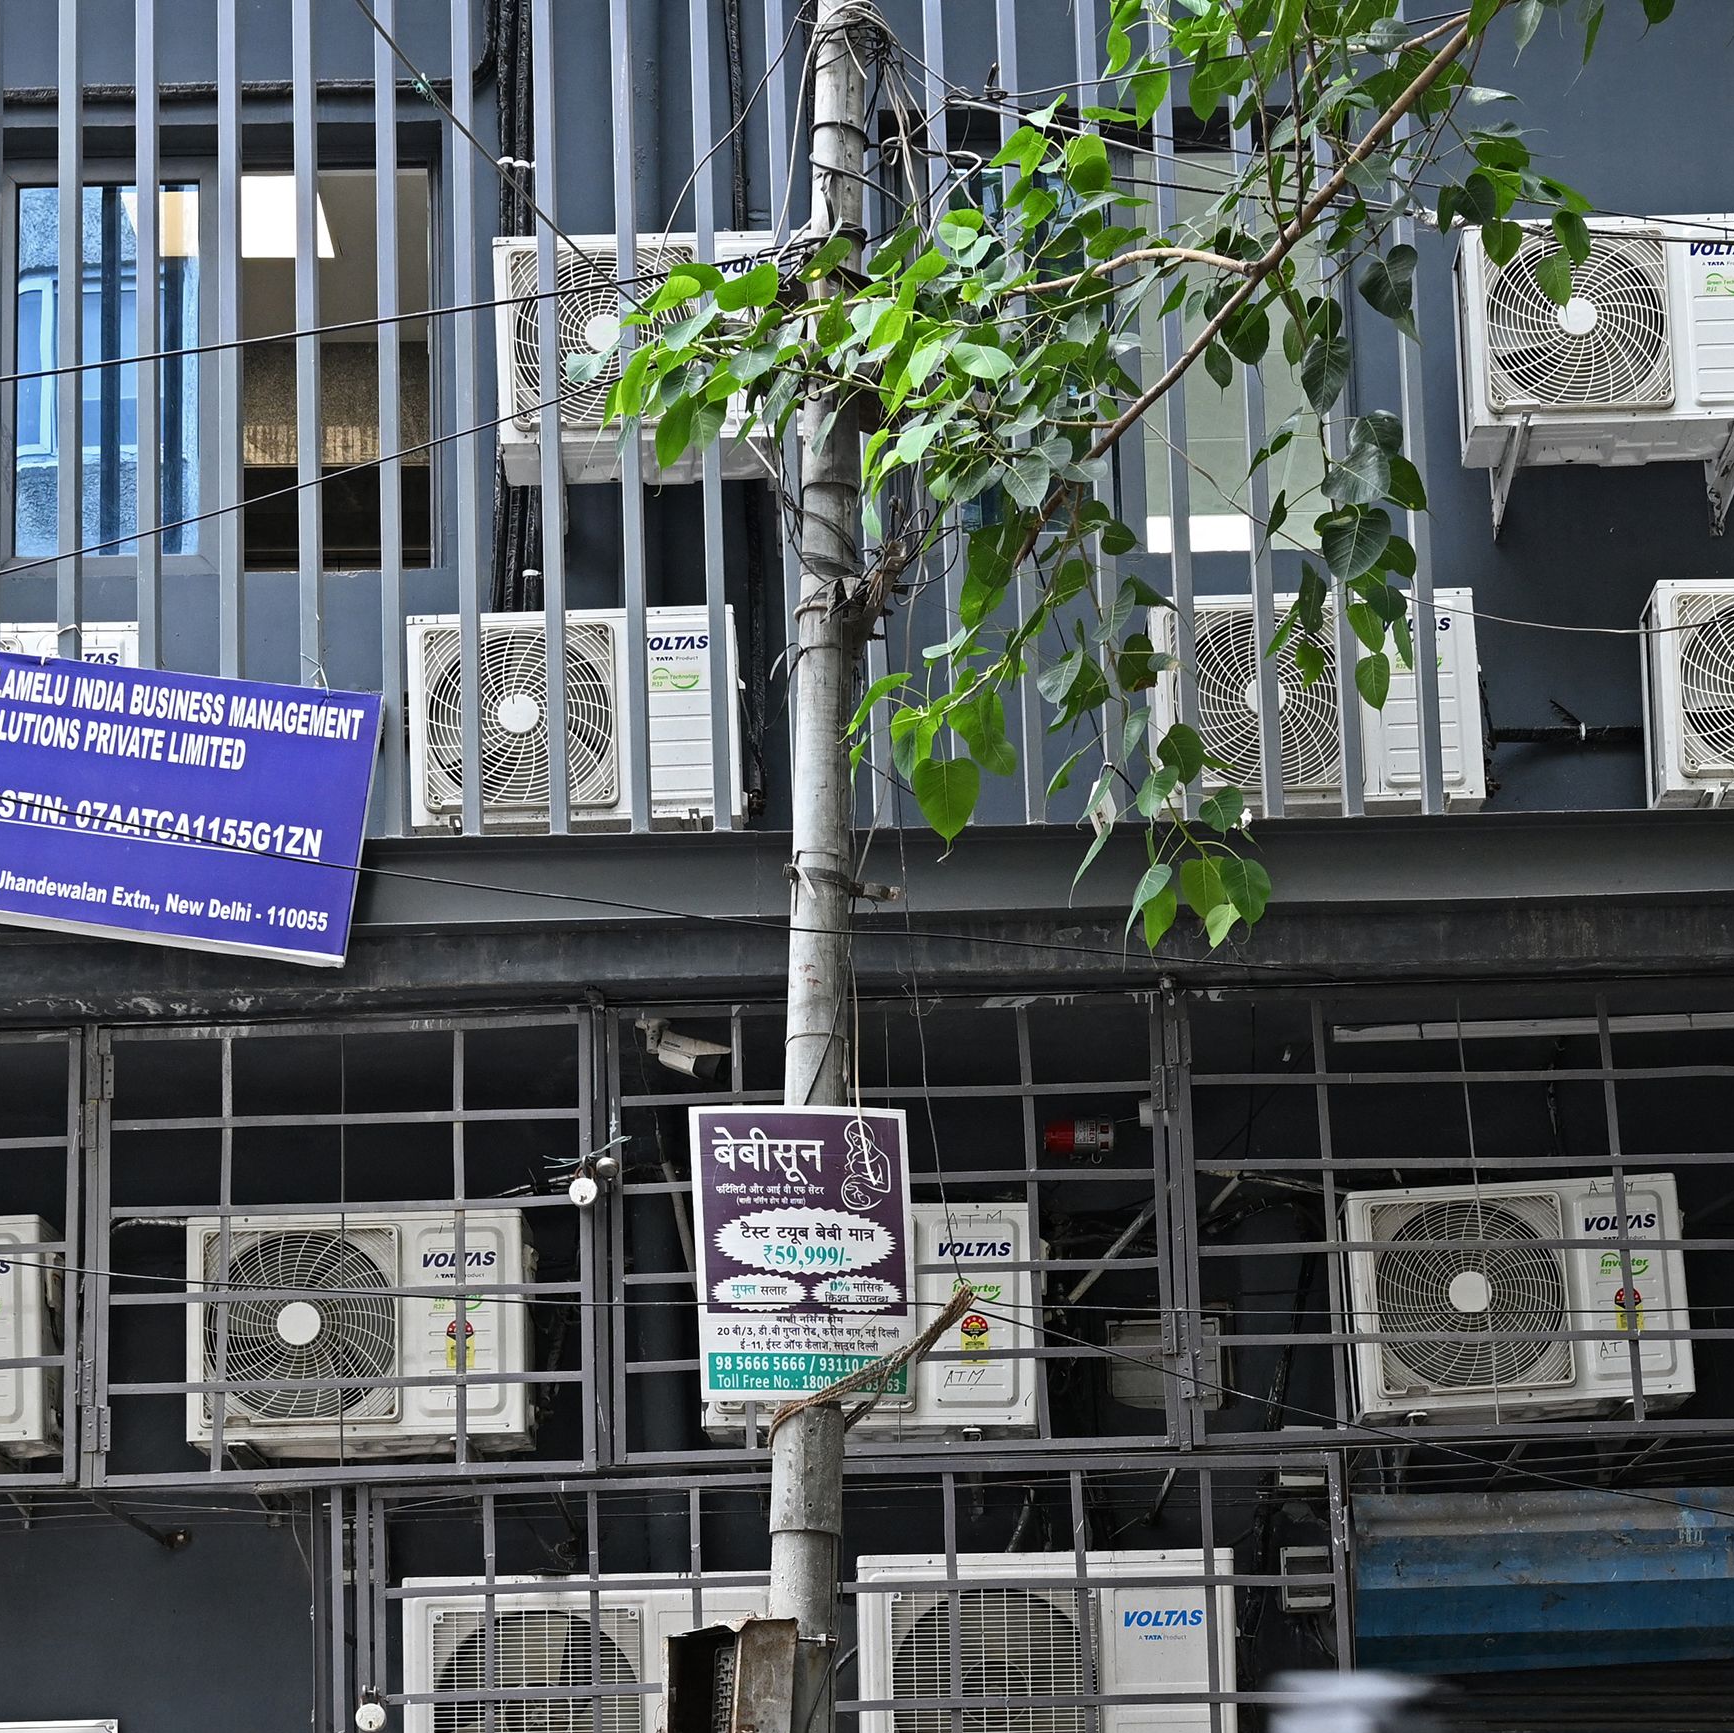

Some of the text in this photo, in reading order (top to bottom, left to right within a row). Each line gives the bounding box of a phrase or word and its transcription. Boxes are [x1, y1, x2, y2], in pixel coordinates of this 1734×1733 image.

[647, 635, 709, 651] OLTAS
[72, 676, 125, 713] INDIA
[129, 685, 225, 726] BUSINESS
[228, 696, 364, 741] MANAGEMENT
[84, 721, 166, 761] PRIVATE
[167, 733, 246, 771] LIMITED
[111, 886, 160, 914] Extn.,
[166, 893, 202, 918] New
[208, 899, 252, 923] Delhi
[266, 905, 329, 932] 110055
[712, 1127, 824, 1185] बेबीसून
[749, 1183, 764, 1195] और
[766, 1183, 781, 1195] आई
[783, 1183, 792, 1195] वी
[793, 1185, 806, 1195] एफ
[740, 1221, 770, 1239] टैस्ट
[815, 1223, 842, 1241] बेबी
[848, 1228, 875, 1242] मात्र
[763, 1245, 852, 1269] ₹59,999/-
[938, 1242, 1011, 1257] VOLTAS
[1601, 1258, 1649, 1268] Invter
[760, 1285, 788, 1296] सलाह
[830, 1280, 884, 1293] 0% मासिक
[717, 1327, 730, 1336] 20
[783, 1328, 801, 1340] गुप्ता
[865, 1327, 877, 1338] नई
[878, 1328, 900, 1339] दिल्ली
[766, 1339, 782, 1350] ईस्ट
[784, 1339, 803, 1350] ऑफ
[857, 1341, 879, 1351] दिल्ली
[716, 1356, 732, 1371] 98
[736, 1356, 769, 1371] 5666
[773, 1357, 806, 1372] 5666
[809, 1355, 816, 1374] /
[819, 1357, 859, 1373] 93110
[716, 1374, 741, 1389] Toll
[743, 1374, 770, 1389] Free
[1124, 1609, 1203, 1627] VOLTAS
